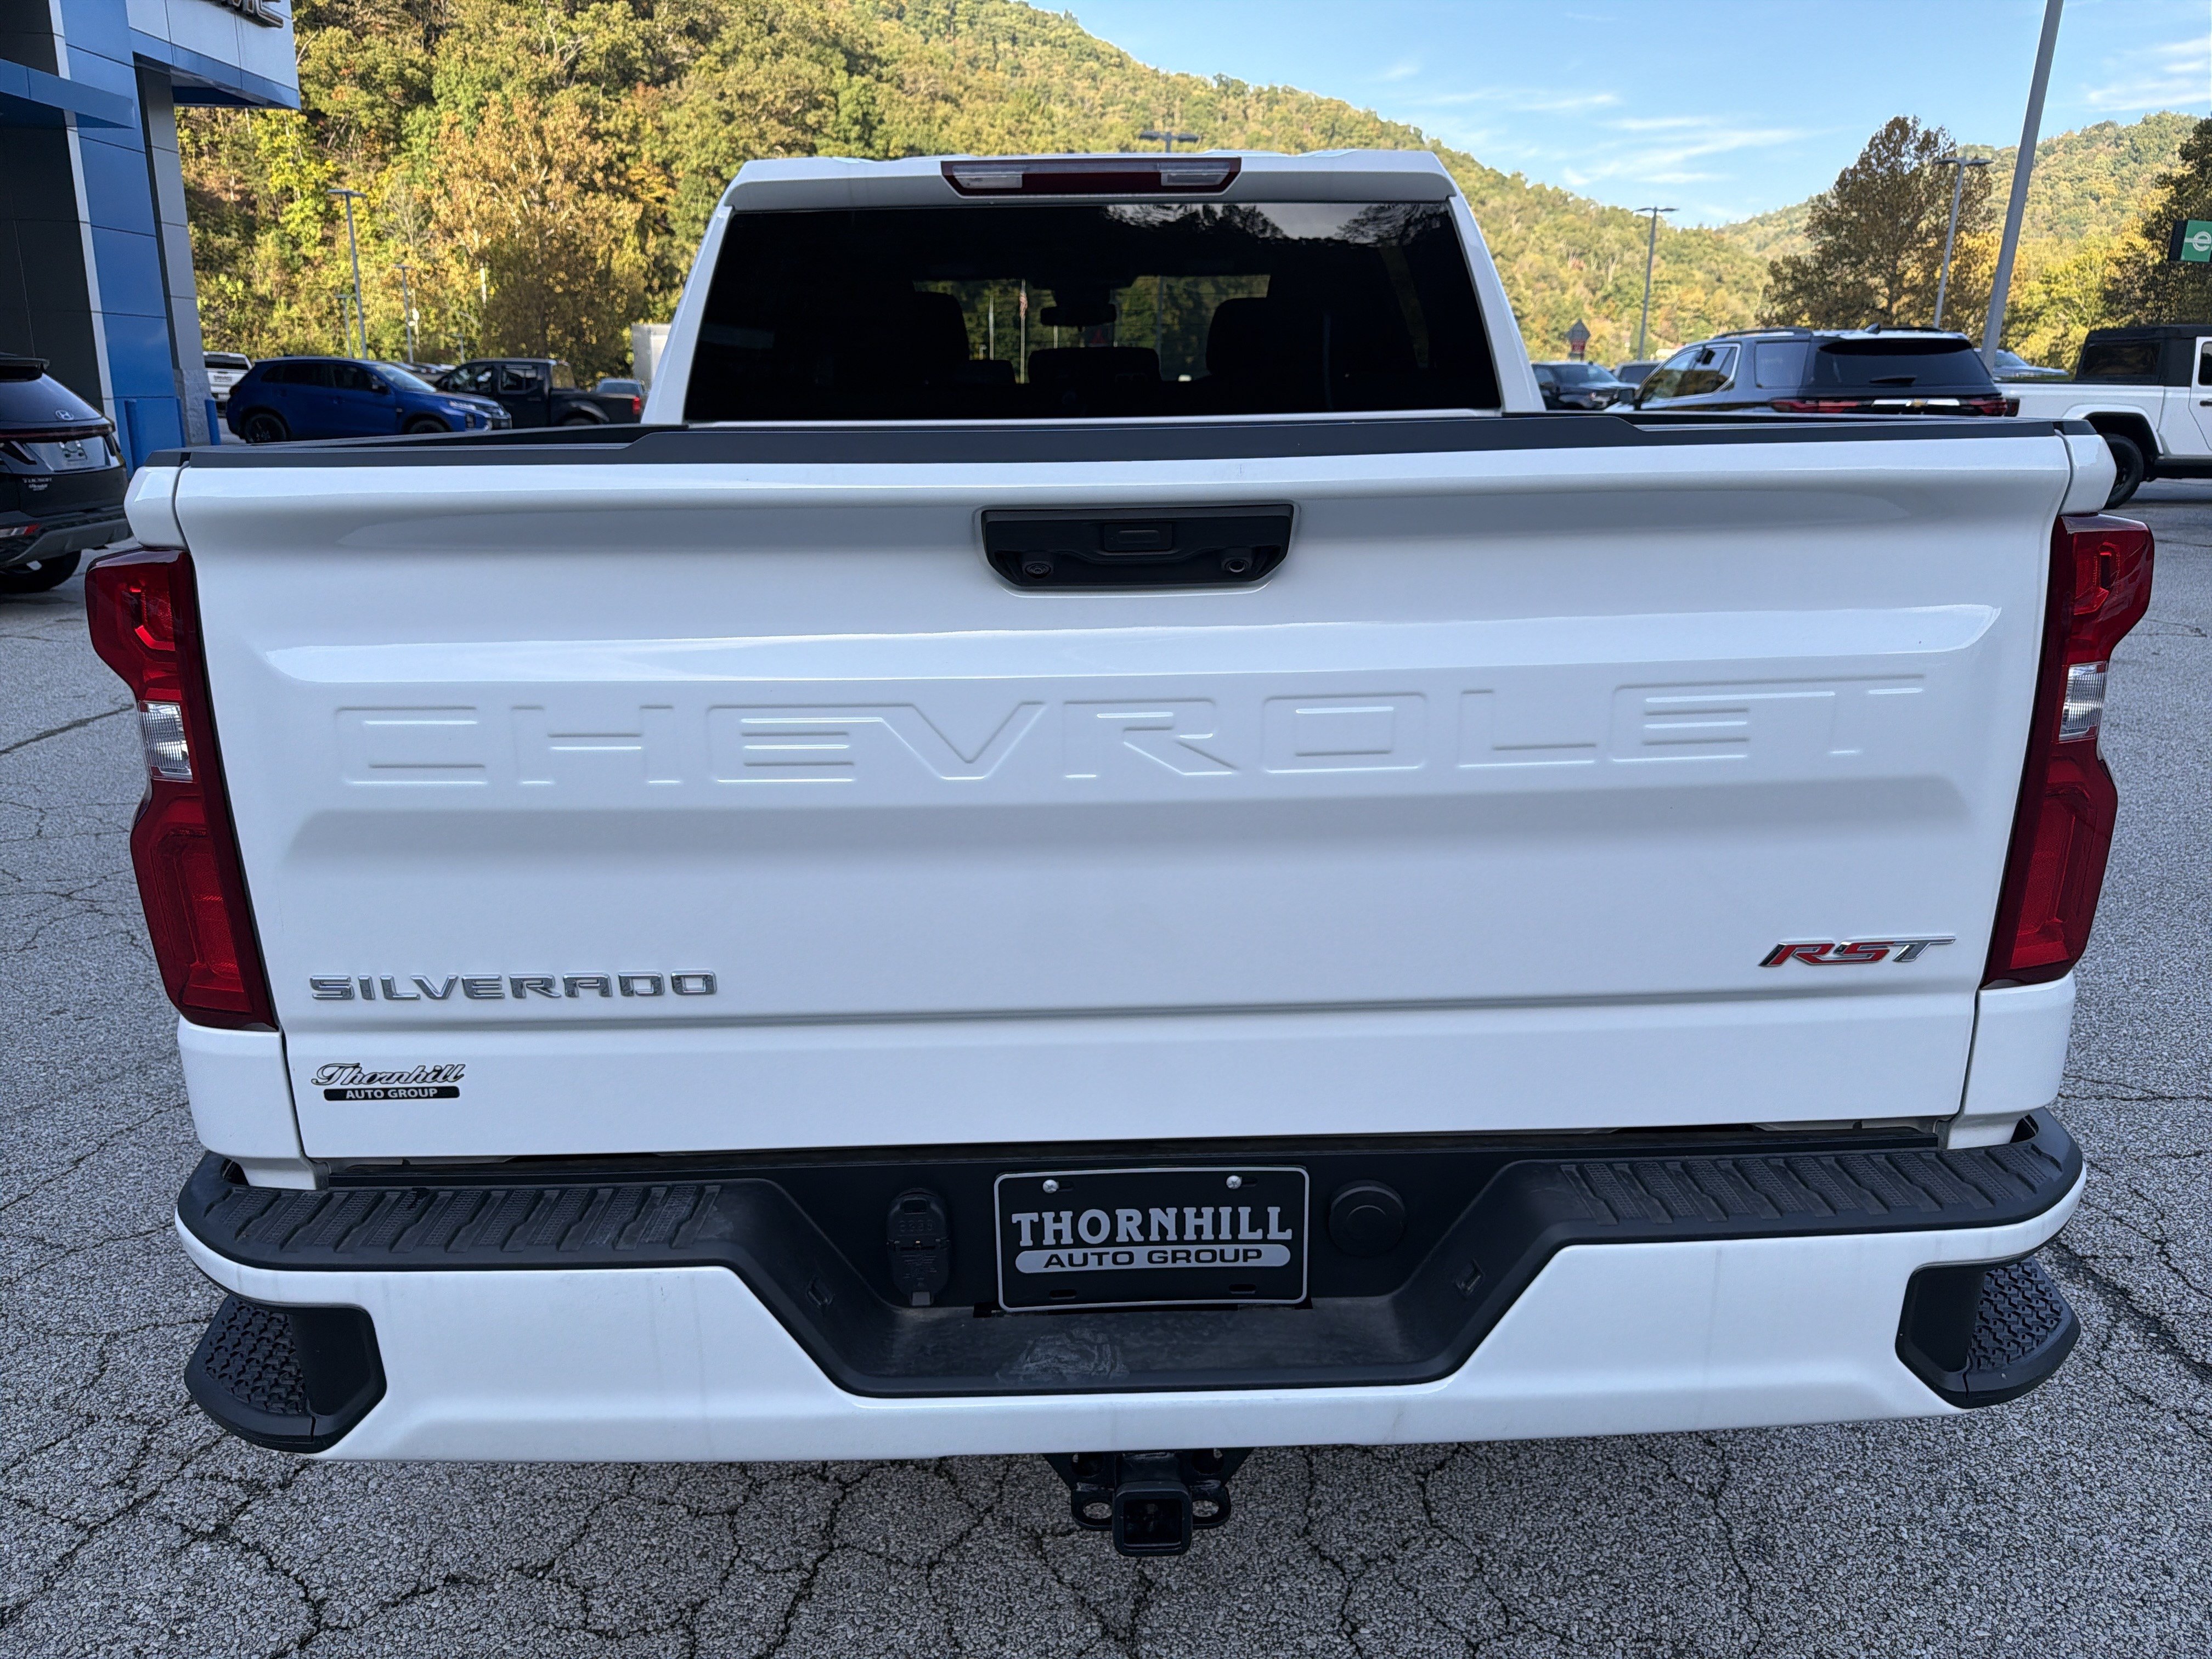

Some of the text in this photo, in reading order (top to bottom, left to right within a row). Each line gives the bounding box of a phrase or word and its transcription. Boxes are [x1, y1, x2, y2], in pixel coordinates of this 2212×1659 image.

[335, 674, 1925, 787] CHEVROLET
[1758, 935, 1956, 968] RST
[309, 970, 716, 1001] SILVERADO
[311, 1062, 466, 1086] Thornhill
[346, 1087, 438, 1099] AUTO GROUP
[1012, 1206, 1293, 1247] THORNHILL
[1043, 1248, 1262, 1269] AUTO GROUP
